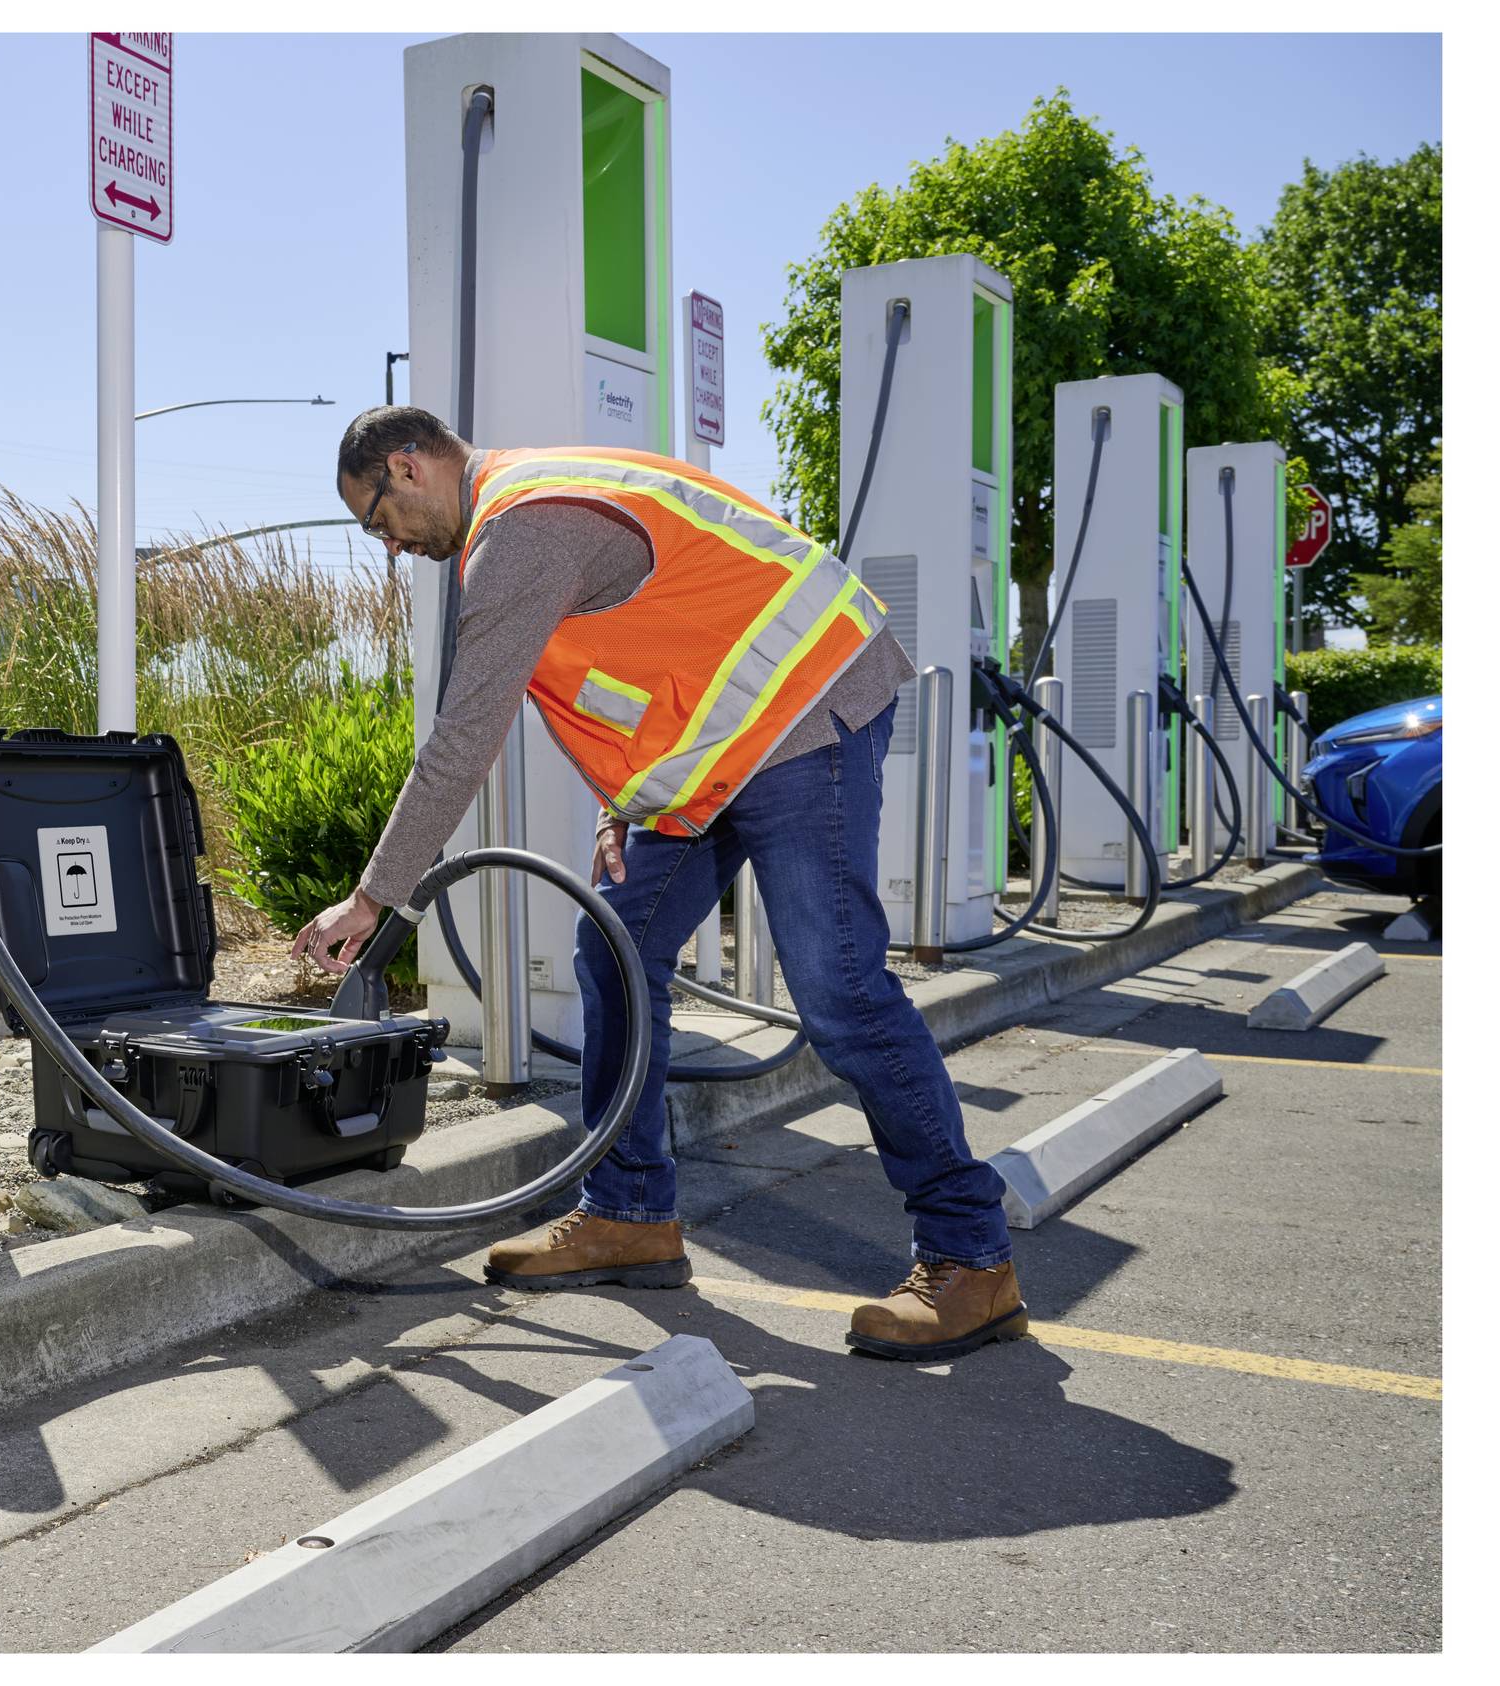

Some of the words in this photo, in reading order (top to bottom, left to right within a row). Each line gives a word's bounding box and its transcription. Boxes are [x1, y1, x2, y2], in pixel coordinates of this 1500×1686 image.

[107, 59, 159, 106] EXCEPT
[111, 101, 154, 144] WHILE
[98, 136, 166, 187] CHARGING
[698, 338, 719, 361] EXCEPT
[700, 364, 717, 386] WHILE
[696, 386, 722, 411] CHARGING
[60, 837, 75, 845] Keep
[76, 837, 86, 845] Dry
